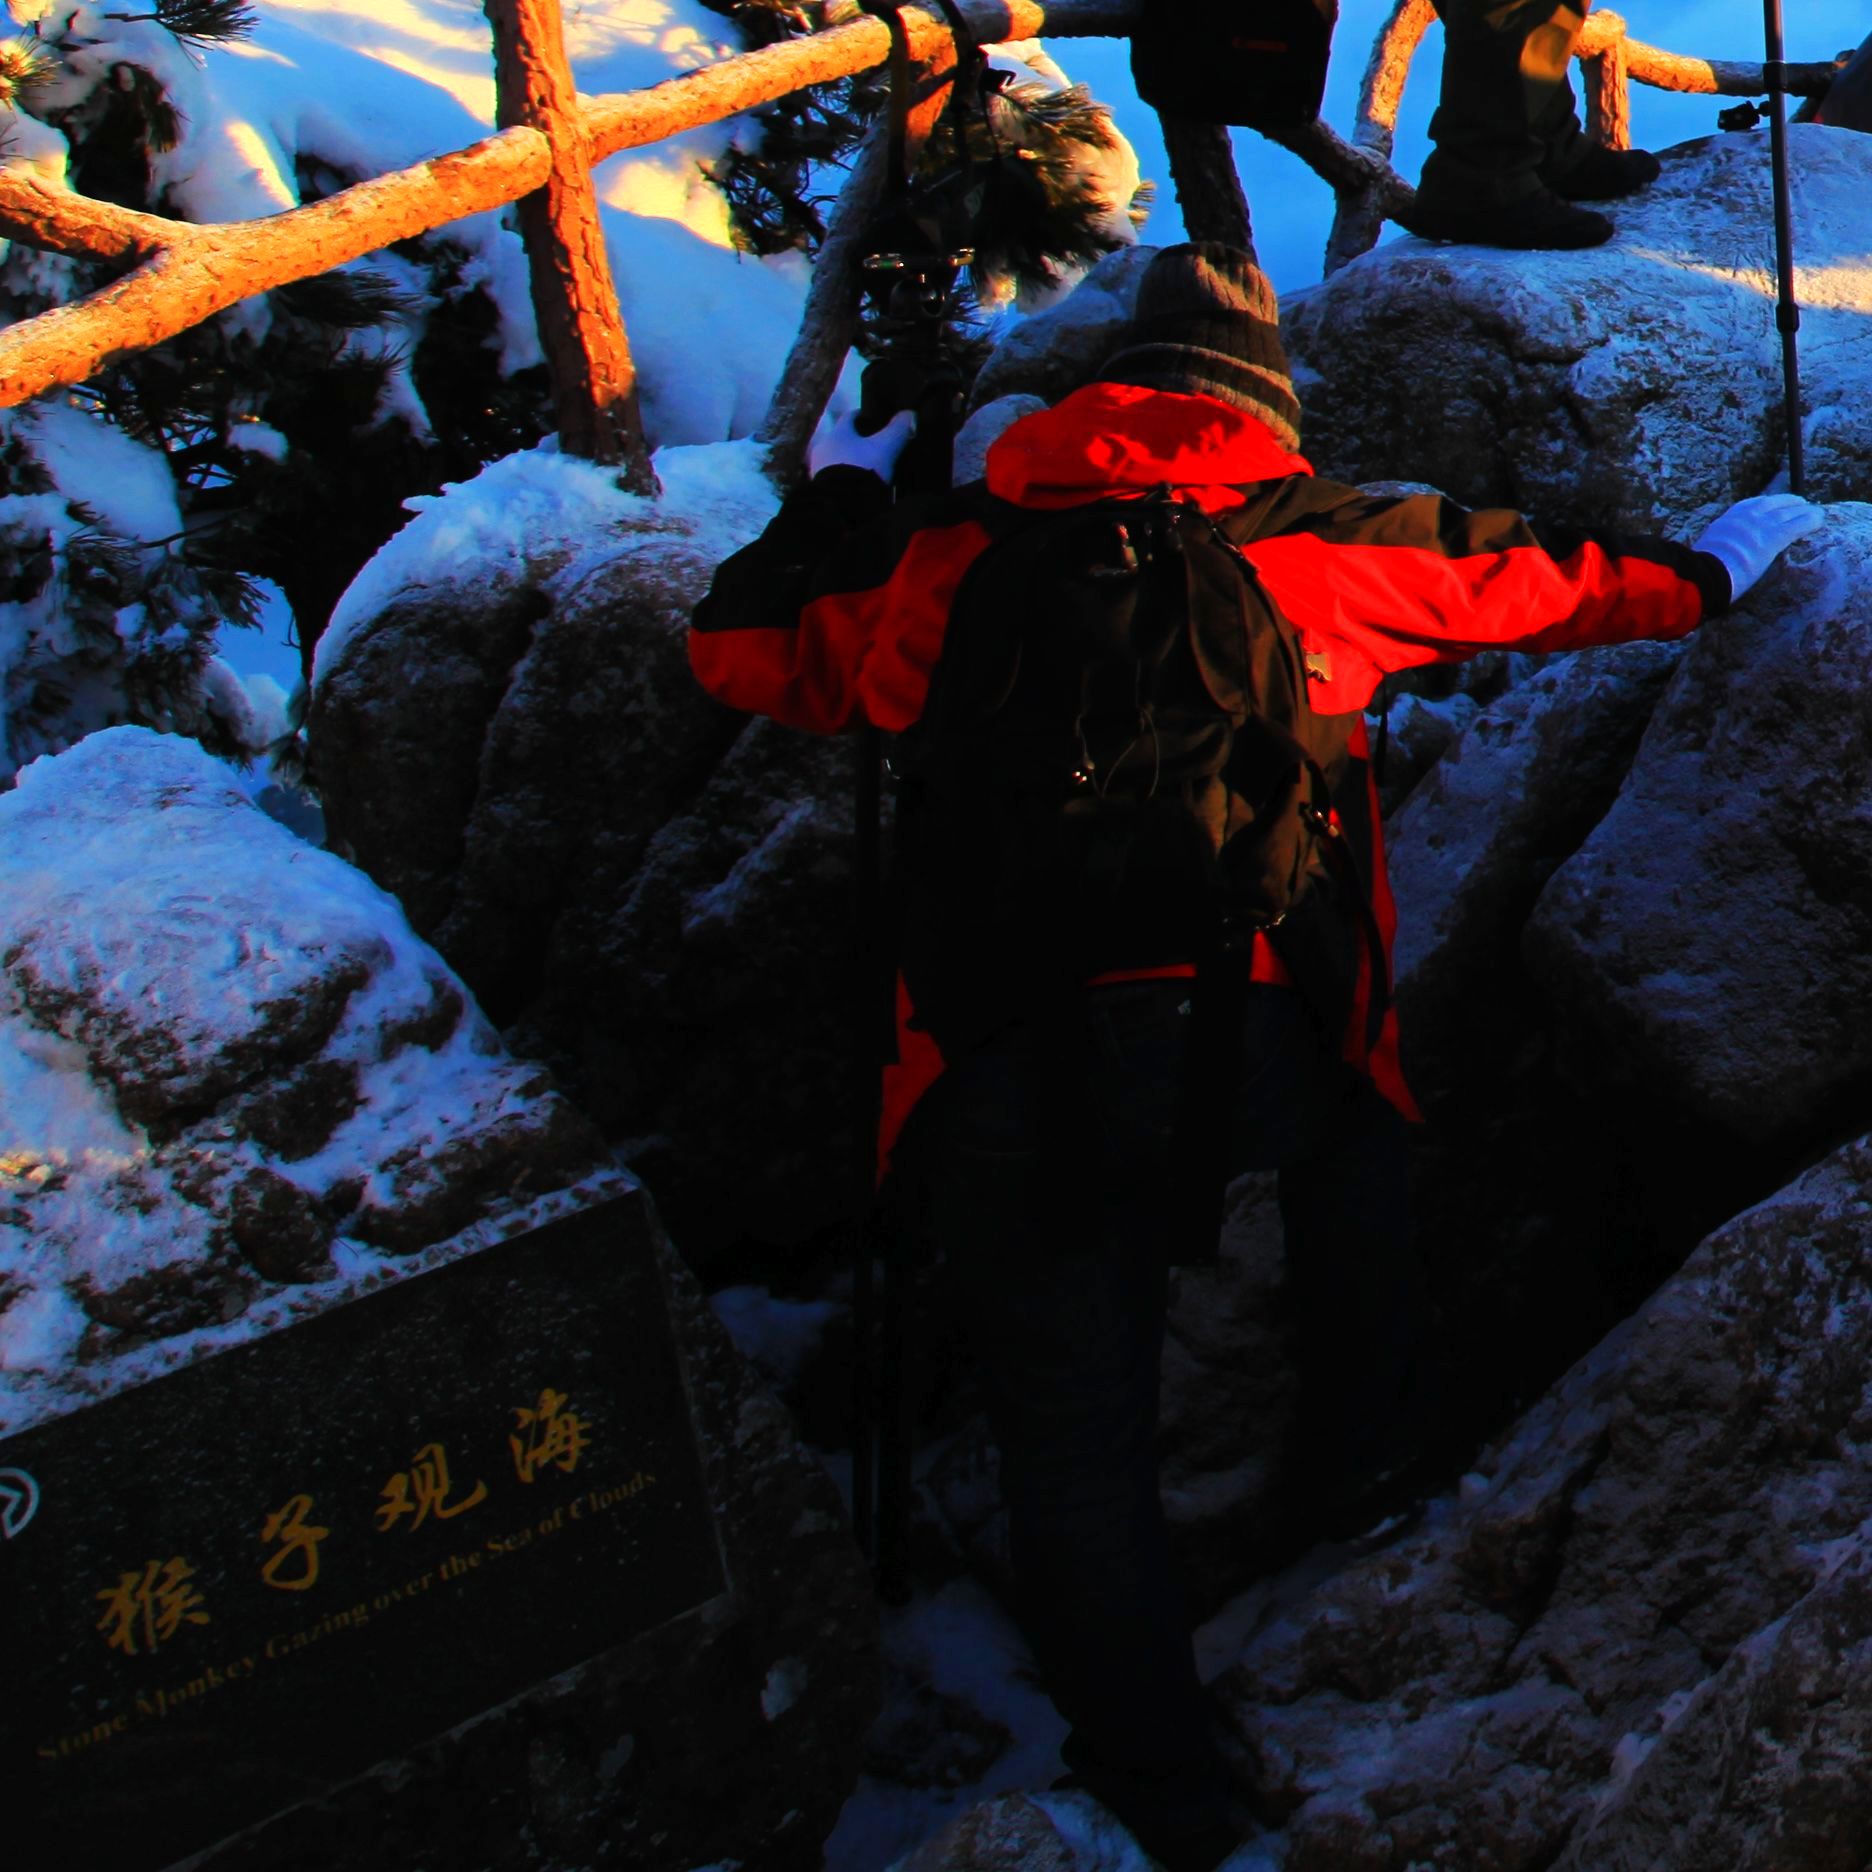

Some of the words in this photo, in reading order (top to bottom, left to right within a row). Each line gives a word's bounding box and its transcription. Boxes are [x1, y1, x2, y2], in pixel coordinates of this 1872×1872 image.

[34, 1711, 129, 1762] Stone
[133, 1652, 258, 1720] Monkey
[264, 1600, 371, 1661] Gazing
[373, 1570, 435, 1612] over
[439, 1549, 481, 1584] the
[485, 1531, 536, 1561] Sea
[538, 1508, 567, 1536] of
[568, 1470, 658, 1520] Clouds
[95, 1386, 592, 1655] 猴子观海
